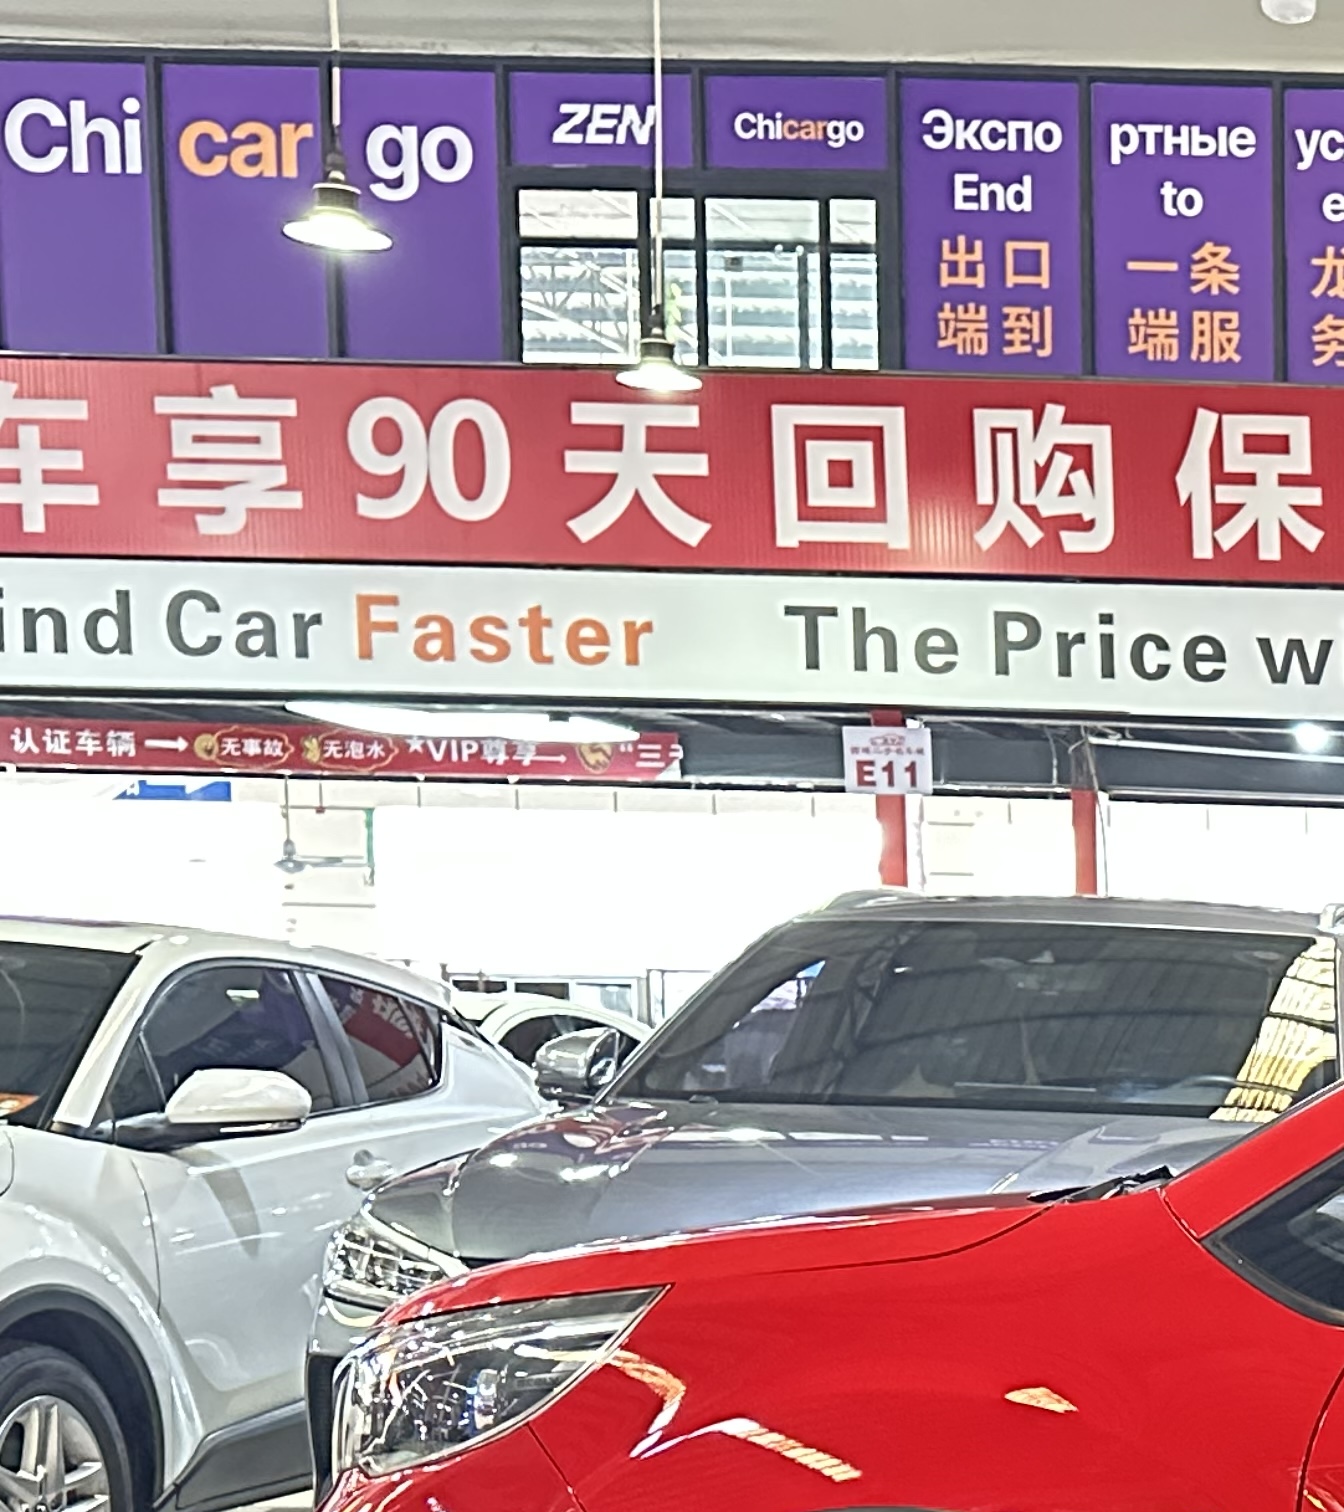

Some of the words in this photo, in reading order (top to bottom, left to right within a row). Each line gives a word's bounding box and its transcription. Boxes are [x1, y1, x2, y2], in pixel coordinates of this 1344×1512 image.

[3, 96, 143, 176] Chi
[178, 119, 313, 180] car
[365, 123, 474, 203] go
[552, 103, 655, 145] ZEN
[734, 111, 865, 149] Chicargo
[922, 109, 1062, 152] Экспо
[1110, 122, 1256, 164] ртные
[954, 174, 1032, 212] End
[1160, 181, 1204, 217] to
[939, 235, 1051, 290] 出口
[1126, 242, 1241, 296] 一条
[936, 302, 1054, 358] 端到
[1127, 308, 1243, 364] 端服
[0, 587, 134, 656] nd
[165, 590, 323, 660] Car
[354, 593, 655, 668] Faster
[783, 605, 960, 676] The
[991, 610, 1228, 683] Price
[10, 727, 136, 758] 认证车辆
[855, 760, 918, 788] E11
